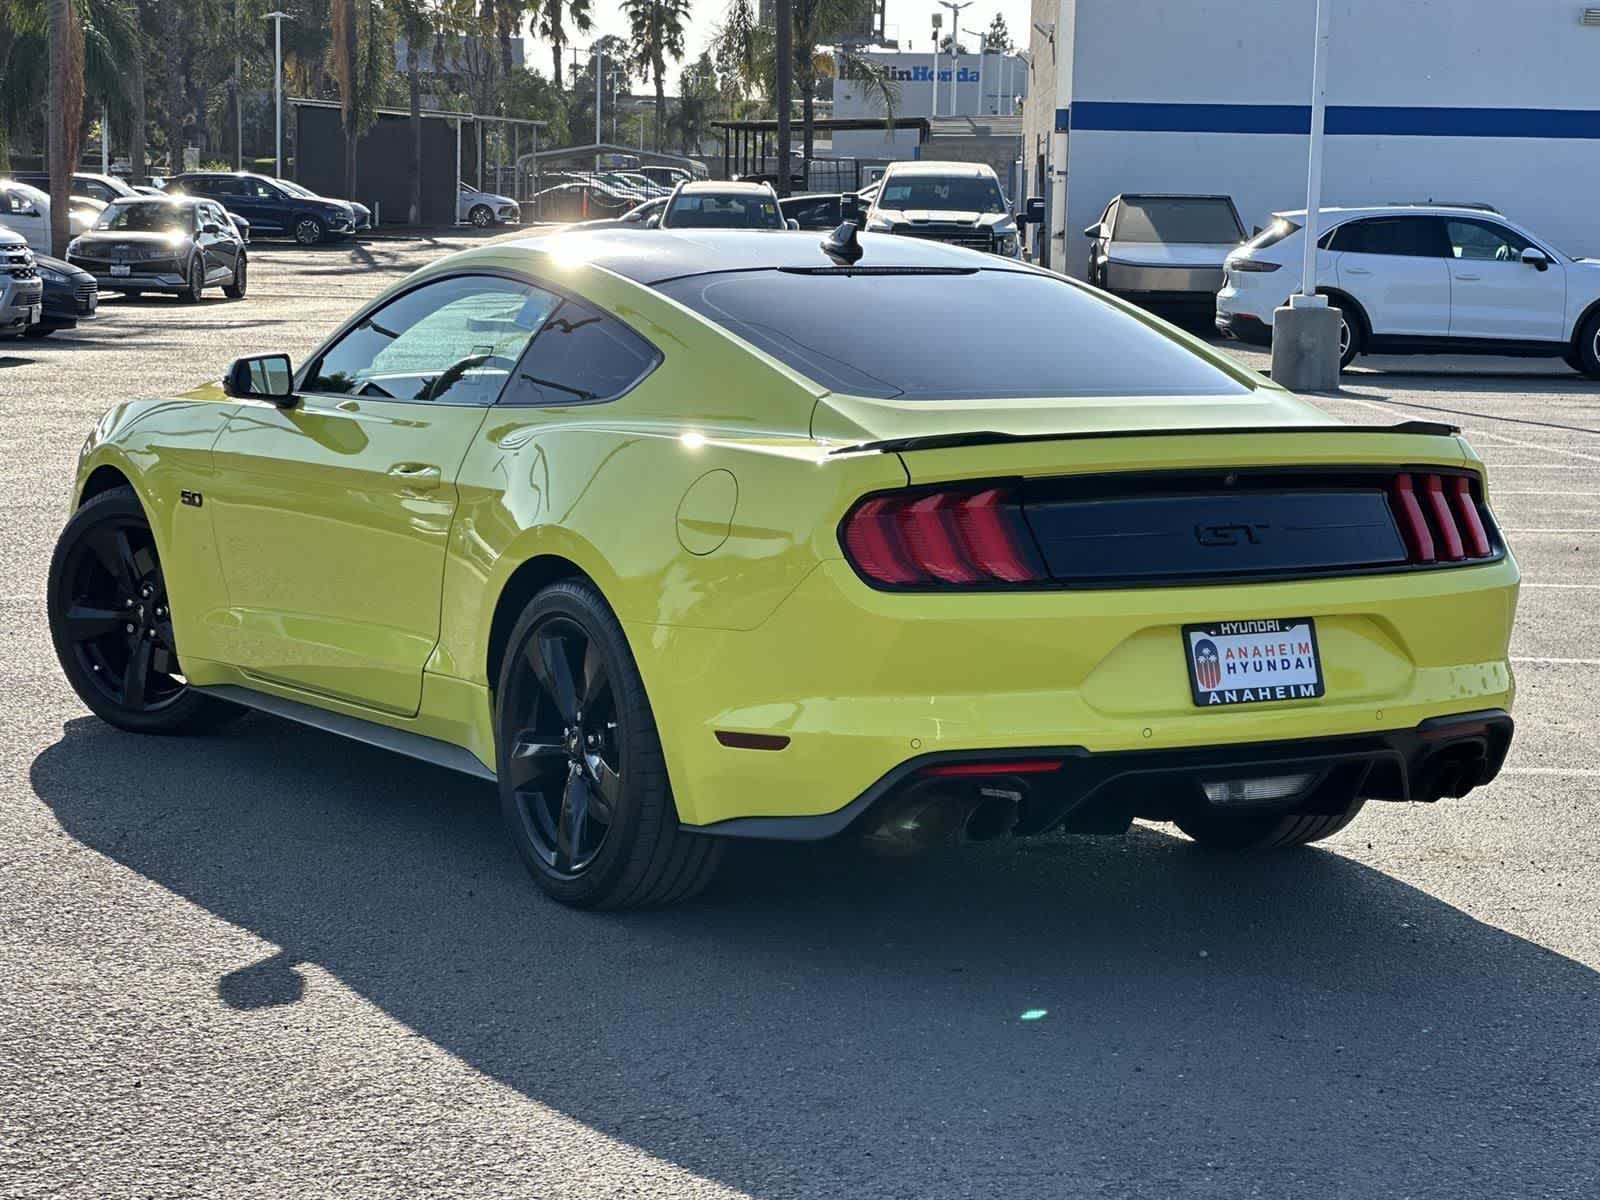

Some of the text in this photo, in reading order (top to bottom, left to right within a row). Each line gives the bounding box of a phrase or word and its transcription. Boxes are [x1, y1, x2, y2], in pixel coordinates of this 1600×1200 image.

[1193, 521, 1270, 547] GT
[1221, 620, 1280, 635] HYUNDAI
[1225, 642, 1310, 660] ANAHEIM
[1227, 657, 1313, 675] HYUNDAI
[1208, 685, 1316, 704] ANAHEIM
